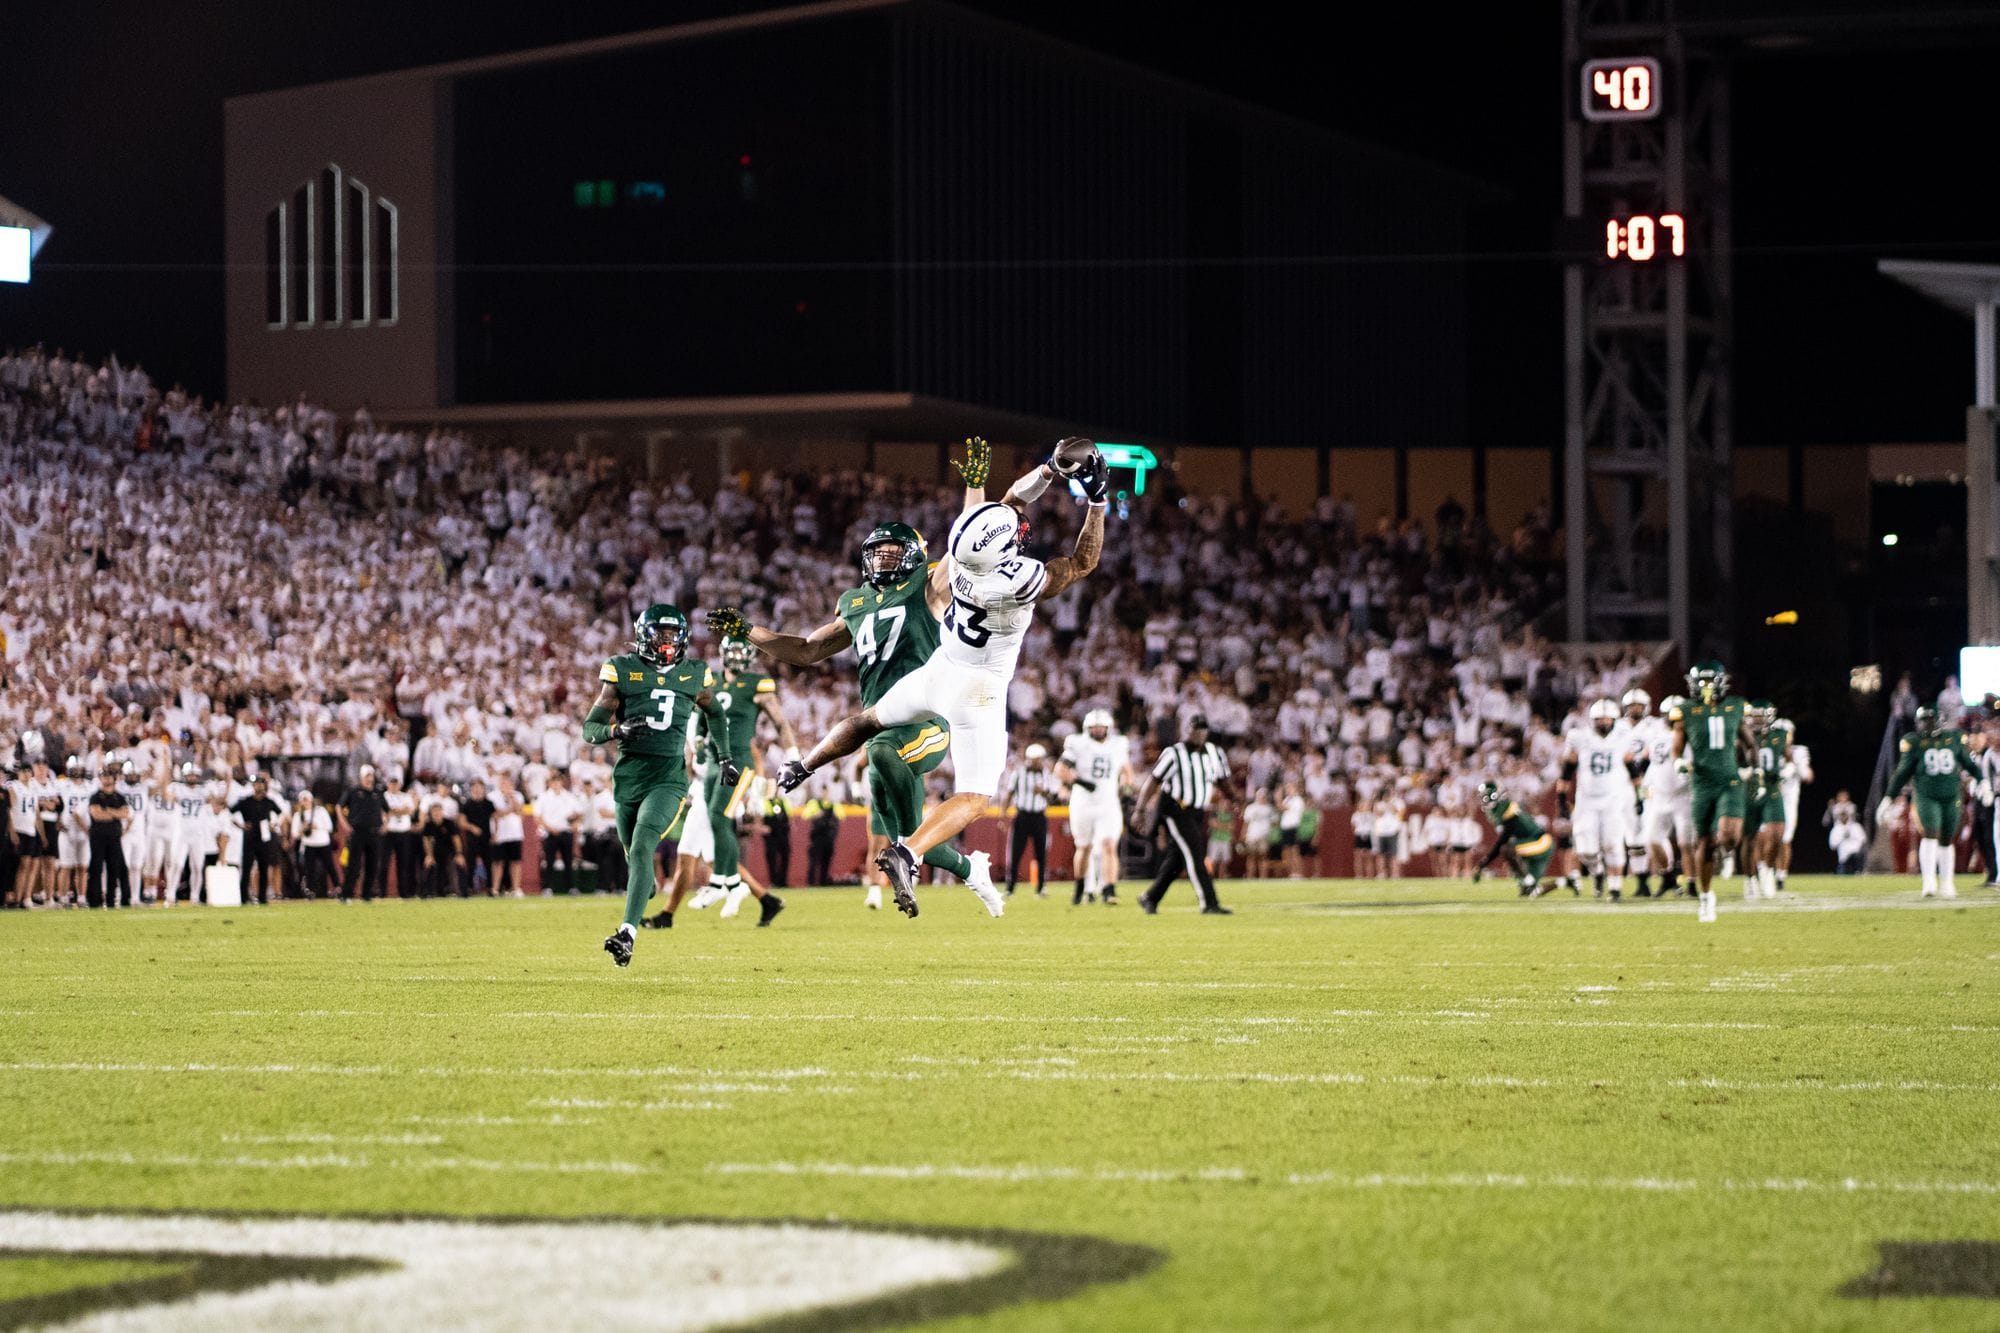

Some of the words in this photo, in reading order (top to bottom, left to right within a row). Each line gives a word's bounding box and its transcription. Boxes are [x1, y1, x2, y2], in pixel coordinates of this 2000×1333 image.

[1594, 66, 1650, 111] 40
[1607, 215, 1684, 260] 1:07
[972, 523, 1012, 552] Cyclones
[954, 573, 974, 599] NOEL
[856, 605, 906, 665] 47
[646, 688, 676, 731] 3
[1708, 716, 1726, 749] 11
[1092, 756, 1112, 779] 61
[1591, 751, 1613, 775] 61
